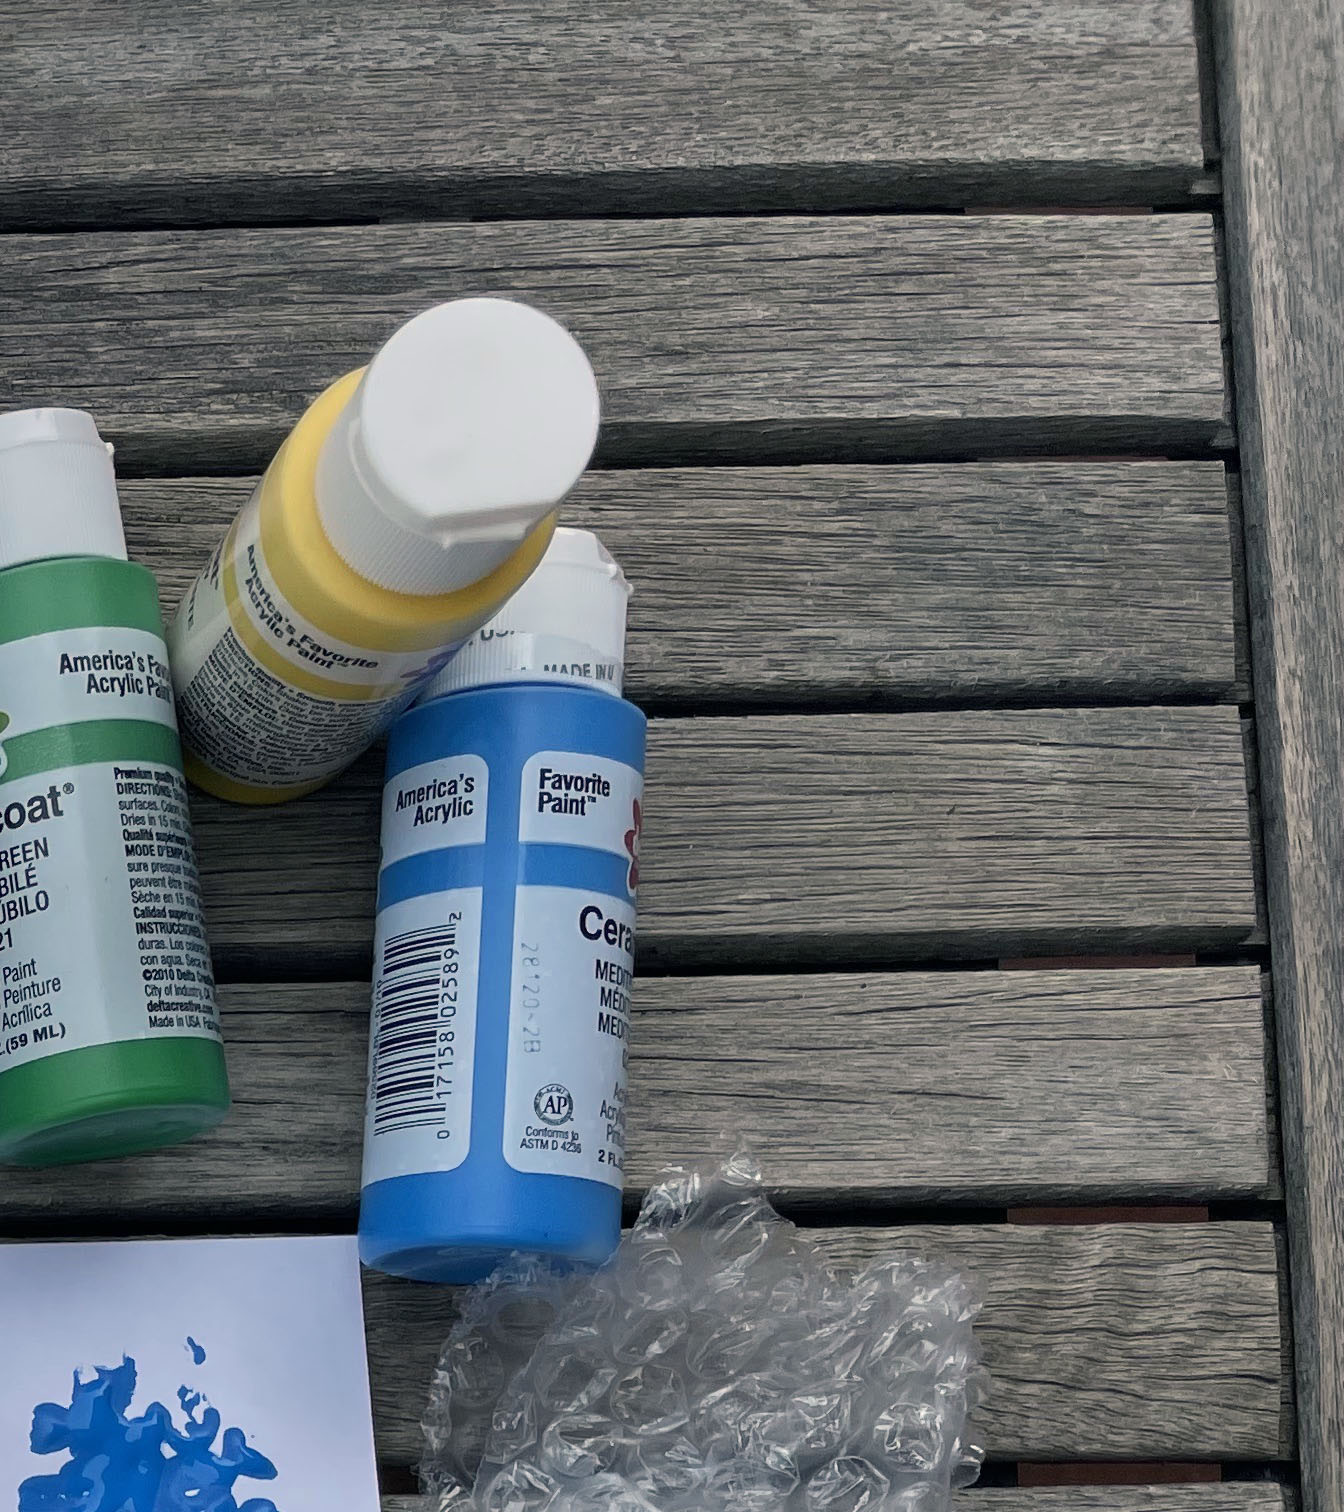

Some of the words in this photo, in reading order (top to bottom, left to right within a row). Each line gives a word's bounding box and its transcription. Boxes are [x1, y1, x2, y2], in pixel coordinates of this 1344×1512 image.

[245, 578, 284, 638] Acrylic
[247, 545, 296, 635] America's
[300, 634, 378, 668] Favorite
[59, 649, 145, 675] America's
[87, 673, 144, 697] Acrylic
[395, 774, 475, 813] America's
[539, 768, 610, 797] Favorite
[120, 813, 146, 826] Dries
[158, 815, 168, 827] 15
[413, 798, 474, 828] Acrylic
[125, 844, 156, 857] MODE
[131, 890, 160, 904] Sèche
[175, 892, 184, 905] 15
[133, 906, 166, 919] Calidad
[448, 911, 462, 923] 2
[169, 938, 184, 951] Los
[140, 955, 159, 966] con
[3, 958, 37, 986] Paint
[4, 977, 61, 1008] Peinture
[144, 984, 162, 998] City
[164, 984, 173, 996] of
[440, 948, 461, 1019] 02589
[149, 1015, 174, 1028] Made
[185, 1015, 202, 1028] USA
[33, 1022, 66, 1043] ML)
[435, 1030, 456, 1100] 17158
[543, 1095, 568, 1115] AP
[436, 1129, 450, 1140] 0
[525, 1125, 569, 1140] Conforms
[571, 1130, 579, 1143] to
[519, 1138, 549, 1150] ASTM
[552, 1139, 559, 1151] D
[561, 1142, 582, 1154] 4236
[598, 1149, 605, 1163] 2
